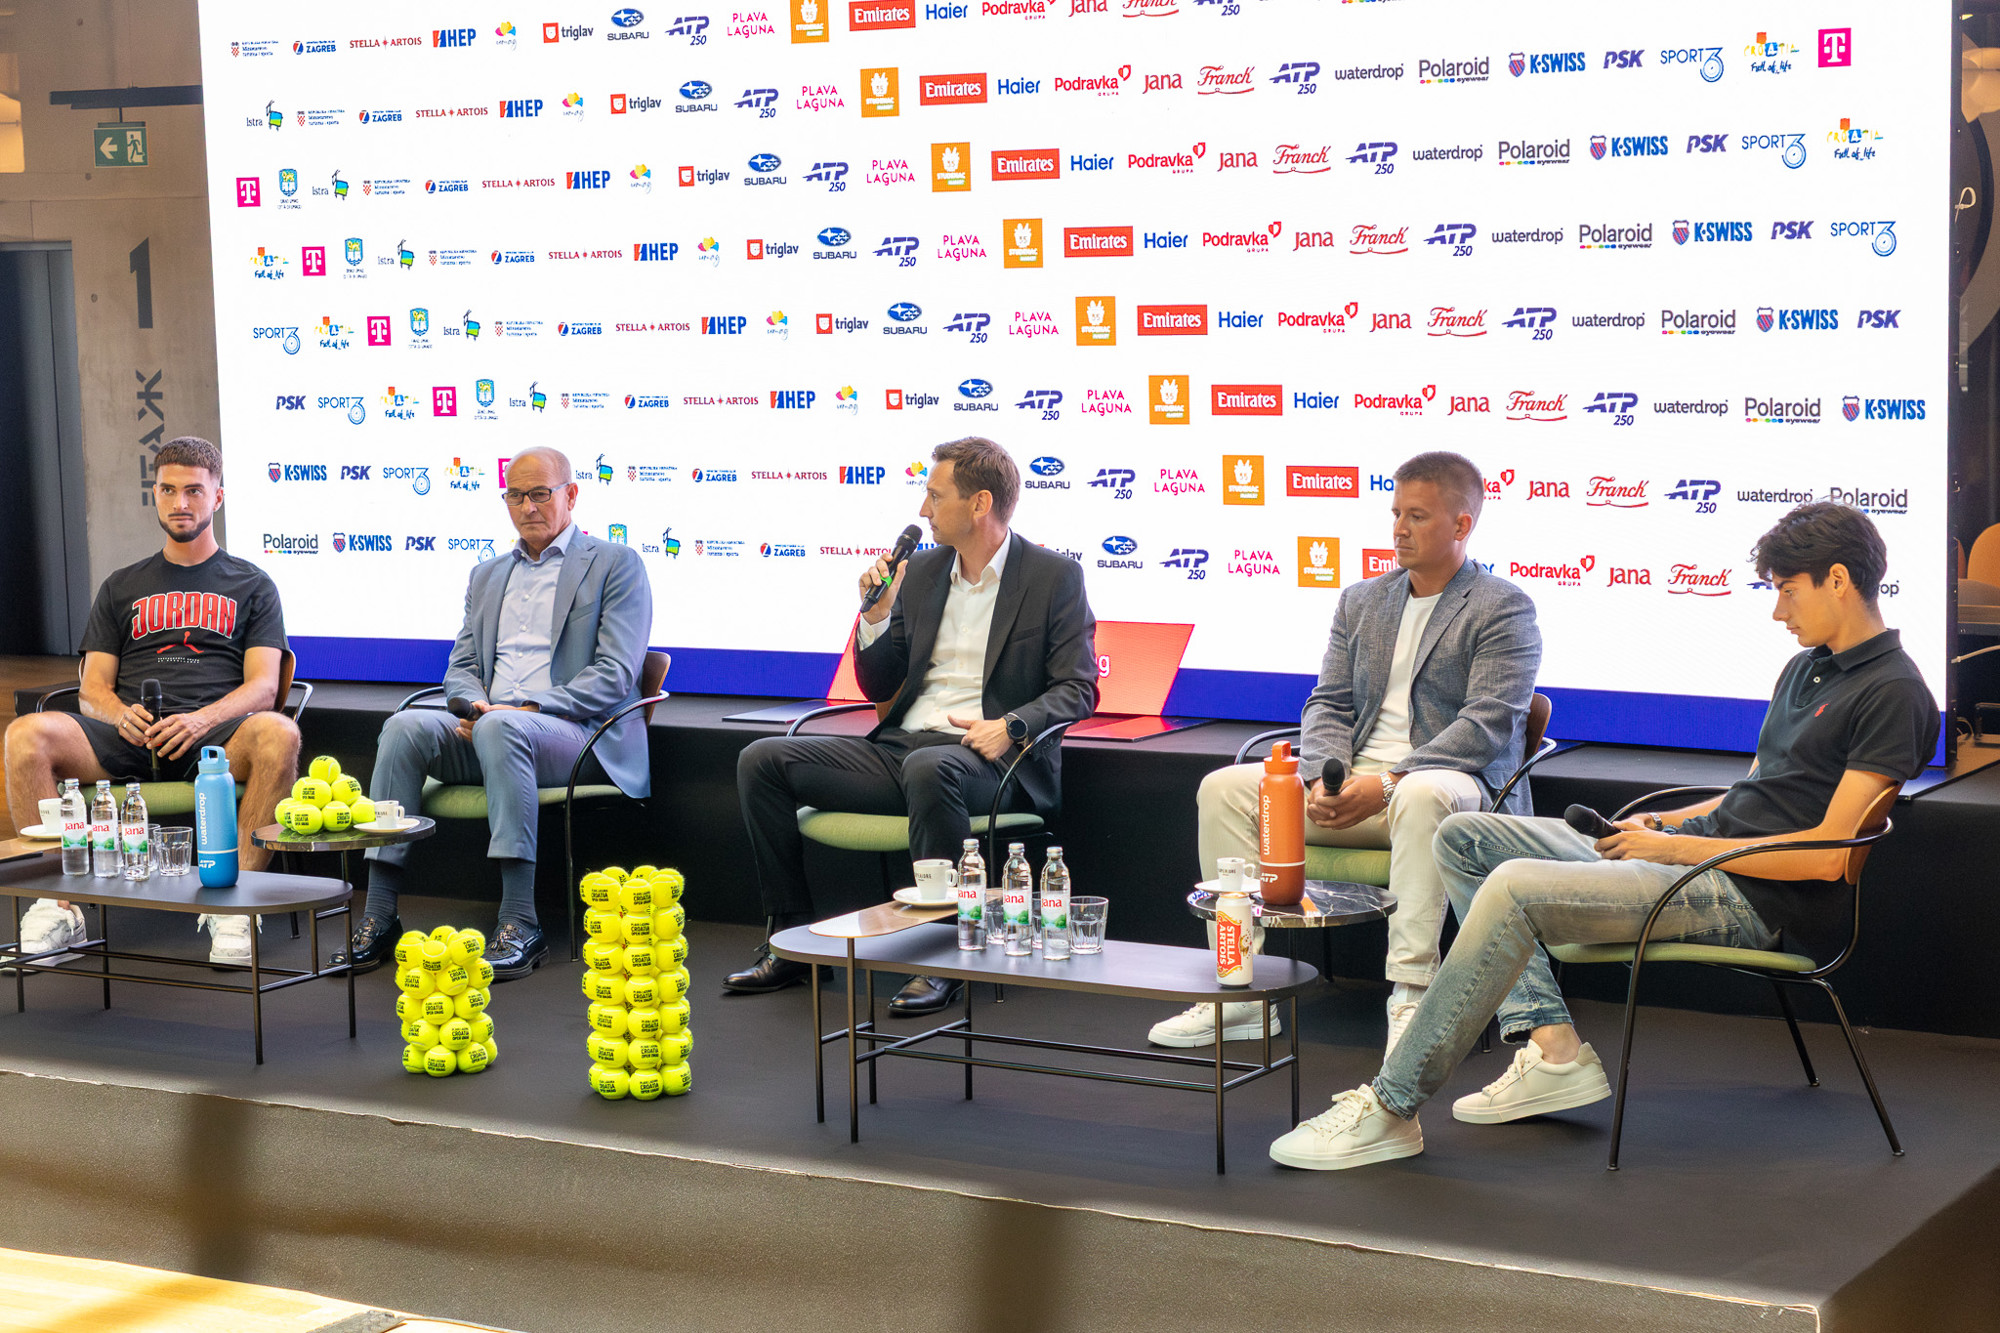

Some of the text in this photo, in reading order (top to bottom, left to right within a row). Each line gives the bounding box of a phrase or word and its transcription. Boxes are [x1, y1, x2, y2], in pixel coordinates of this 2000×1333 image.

[854, 7, 910, 23] Emirates
[926, 2, 968, 20] Haier
[982, 0, 1043, 16] Podravka
[561, 25, 593, 41] triglav
[607, 32, 649, 41] SUBARU
[306, 45, 336, 53] ZAGREB
[350, 37, 422, 48] STELLA ARTOIS
[1419, 56, 1489, 79] Polaroid
[1603, 50, 1645, 69] PSK
[1197, 65, 1255, 86] Franck
[1269, 62, 1320, 83] ATP
[1335, 63, 1403, 80] waterdrop
[802, 85, 837, 96] PLAVA
[925, 81, 982, 97] Emirates
[998, 77, 1040, 95] Haier
[1055, 74, 1121, 91] Podravka
[1298, 83, 1317, 94] 250
[416, 107, 488, 118] STELLA ARTOIS
[629, 97, 661, 112] triglav
[676, 104, 717, 113] SUBARU
[797, 98, 844, 112] LAGUNA
[372, 114, 402, 122] ZAGREB
[1346, 142, 1398, 163] ATP
[1413, 144, 1483, 162] waterdrop
[1499, 139, 1570, 161] Polaroid
[872, 160, 908, 170] PLAVA
[997, 157, 1054, 173] Emirates
[1071, 154, 1114, 171] Haier
[1375, 163, 1394, 174] 250
[697, 169, 730, 185] triglav
[867, 172, 915, 186] LAGUNA
[1203, 230, 1271, 247] Podravka
[1350, 224, 1409, 245] Franck
[1492, 228, 1563, 244] waterdrop
[1579, 223, 1652, 243] Polaroid
[1771, 221, 1814, 240] PSK
[549, 250, 622, 259] STELLA ARTOIS
[872, 237, 919, 256] ATP
[505, 255, 535, 263] ZAGREB
[813, 251, 857, 259] SUBARU
[898, 256, 915, 266] 250
[130, 238, 153, 329] 1
[835, 317, 869, 333] triglav
[1015, 312, 1052, 322] PLAVA
[1143, 312, 1201, 327] Emirates
[1219, 310, 1263, 328] Haier
[1278, 310, 1347, 326] Podravka
[1427, 307, 1487, 327] Franck
[1502, 307, 1557, 328] ATP
[1572, 312, 1645, 330] waterdrop
[1662, 309, 1736, 328] Polaroid
[1857, 310, 1901, 328] PSK
[571, 327, 602, 335] ZAGREB
[616, 323, 690, 331] STELLA ARTOIS
[1009, 325, 1059, 338] LAGUNA
[1532, 328, 1552, 339] 250
[638, 400, 669, 408] ZAGREB
[684, 397, 758, 405] STELLA ARTOIS
[905, 393, 939, 409] triglav
[1015, 390, 1063, 407] ATP
[1217, 393, 1277, 408] Emirates
[1294, 392, 1339, 409] Haier
[1355, 392, 1425, 409] Podravka
[1506, 391, 1568, 411] Franck
[1583, 392, 1638, 411] ATP
[954, 403, 998, 411] SUBARU
[1041, 409, 1058, 419] 250
[1654, 400, 1728, 417] waterdrop
[1745, 397, 1820, 417] Polaroid
[1613, 415, 1634, 426] 250
[341, 466, 371, 480] PSK
[706, 472, 737, 482] ZAGREB
[752, 471, 827, 480] STELLA ARTOIS
[1087, 469, 1135, 488] ATP
[1160, 469, 1198, 479] PLAVA
[1292, 473, 1353, 489] Emirates
[1025, 481, 1070, 489] SUBARU
[1154, 482, 1205, 496] LAGUNA
[1587, 476, 1649, 497] Franck
[1664, 479, 1721, 501] ATP
[1114, 489, 1132, 499] 250
[1695, 502, 1717, 513] 250
[263, 534, 318, 549] Polaroid
[405, 536, 436, 551] PSK
[1160, 549, 1209, 568] ATP
[1235, 550, 1273, 561] PLAVA
[1097, 560, 1143, 569] SUBARU
[1228, 563, 1280, 577] LAGUNA
[1510, 560, 1584, 579] Podravka
[1187, 568, 1204, 579] 250
[1668, 564, 1732, 586] Franck
[132, 591, 237, 640] JORDAN
[199, 792, 208, 845] waterdrop
[1263, 795, 1271, 855] waterdrop
[92, 824, 110, 832] ana
[958, 889, 977, 899] ana
[1219, 924, 1227, 966] ARTOIS
[1226, 925, 1236, 966] STELLA
